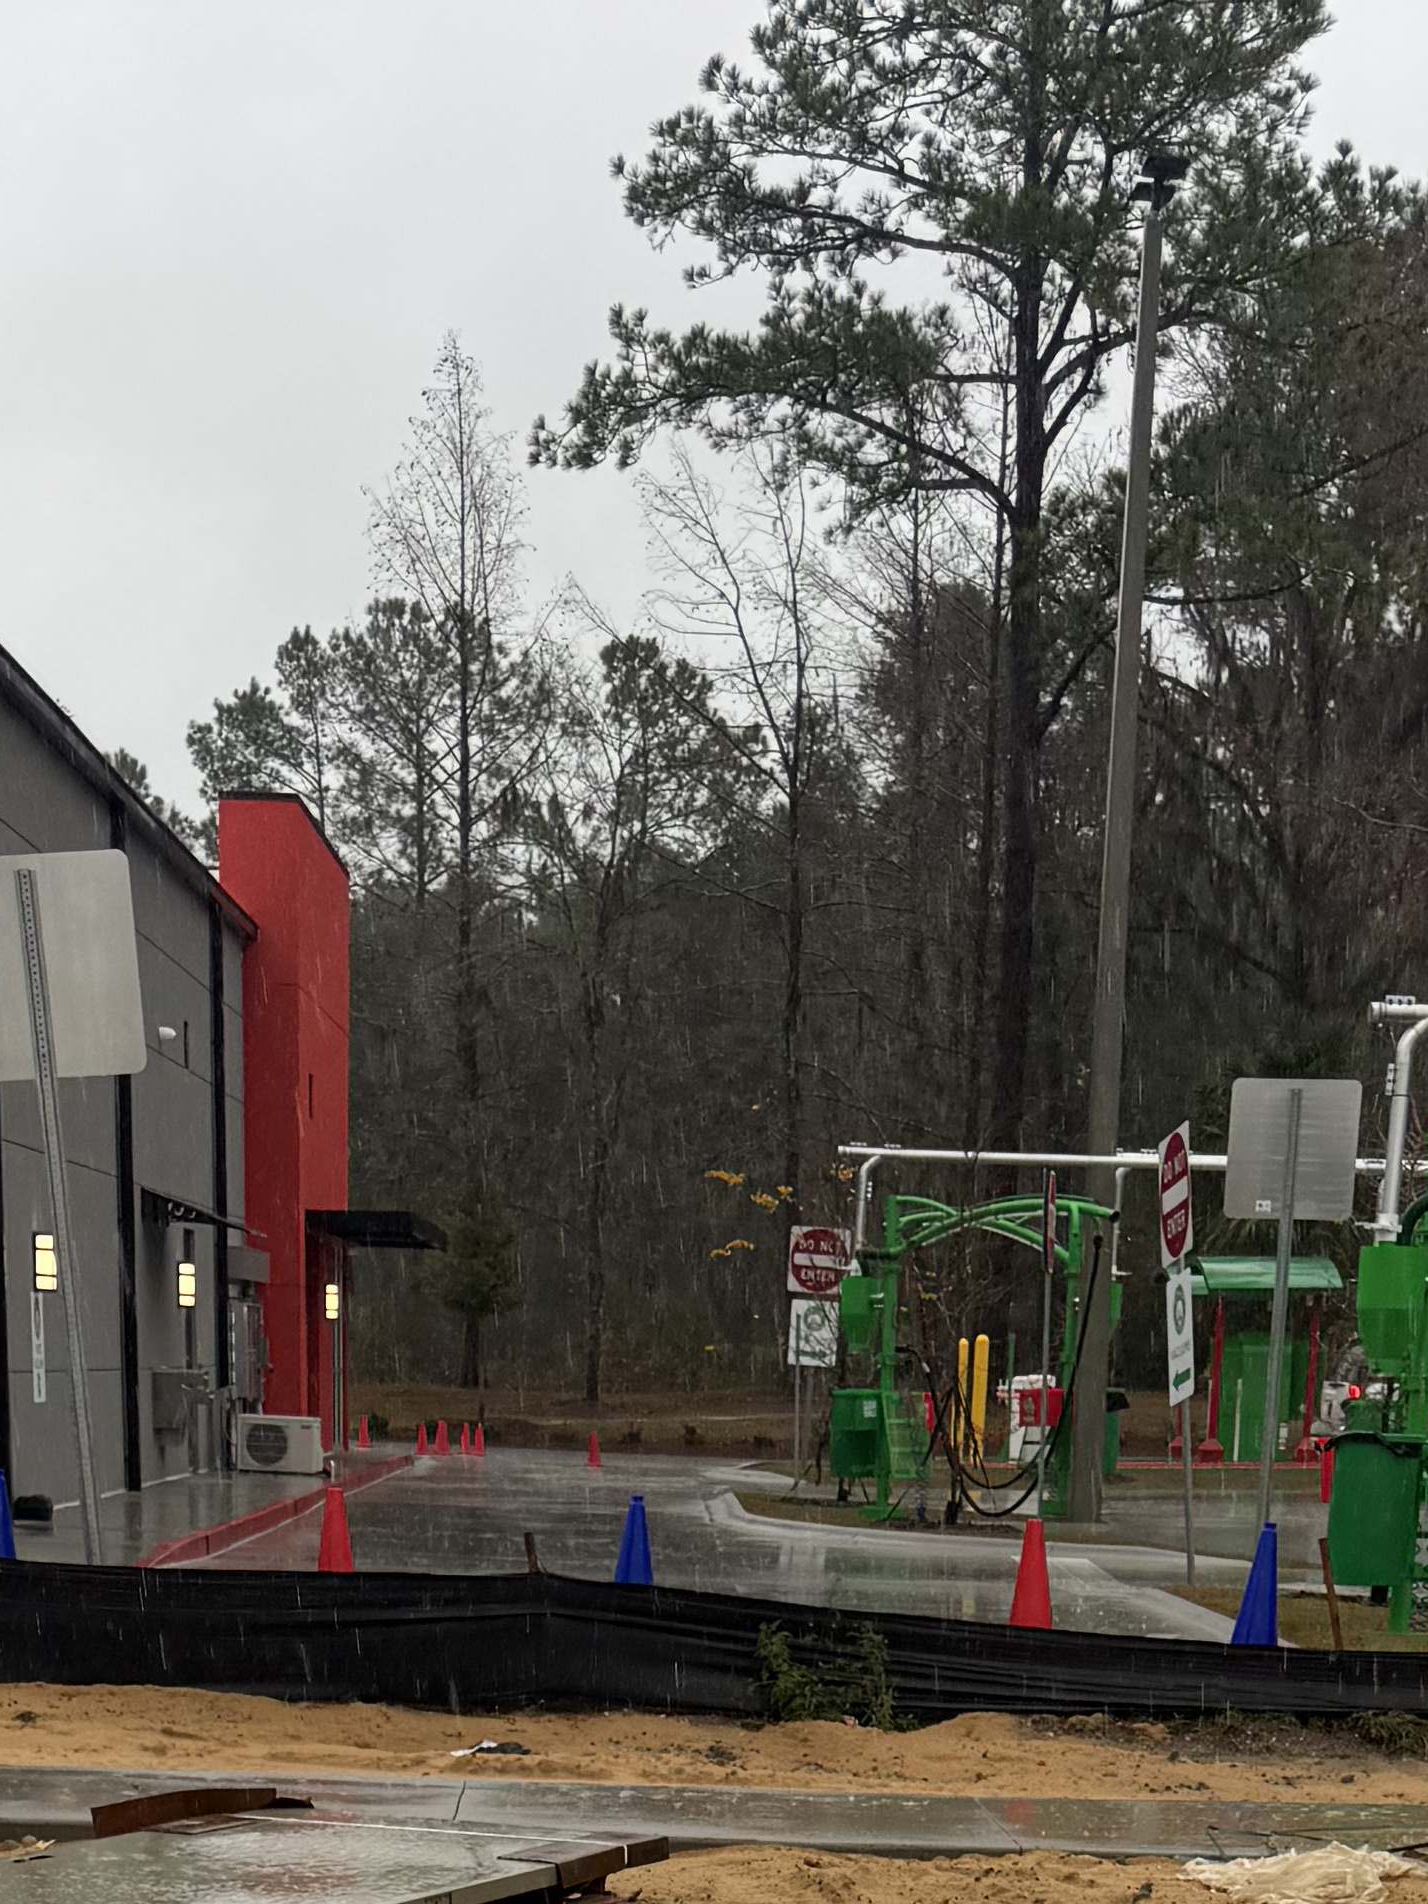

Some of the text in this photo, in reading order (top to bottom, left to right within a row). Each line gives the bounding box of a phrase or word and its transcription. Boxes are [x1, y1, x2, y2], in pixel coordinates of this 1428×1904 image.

[1167, 1209, 1185, 1239] ENTER
[799, 1240, 814, 1250] DO
[801, 1269, 835, 1282] ENTER
